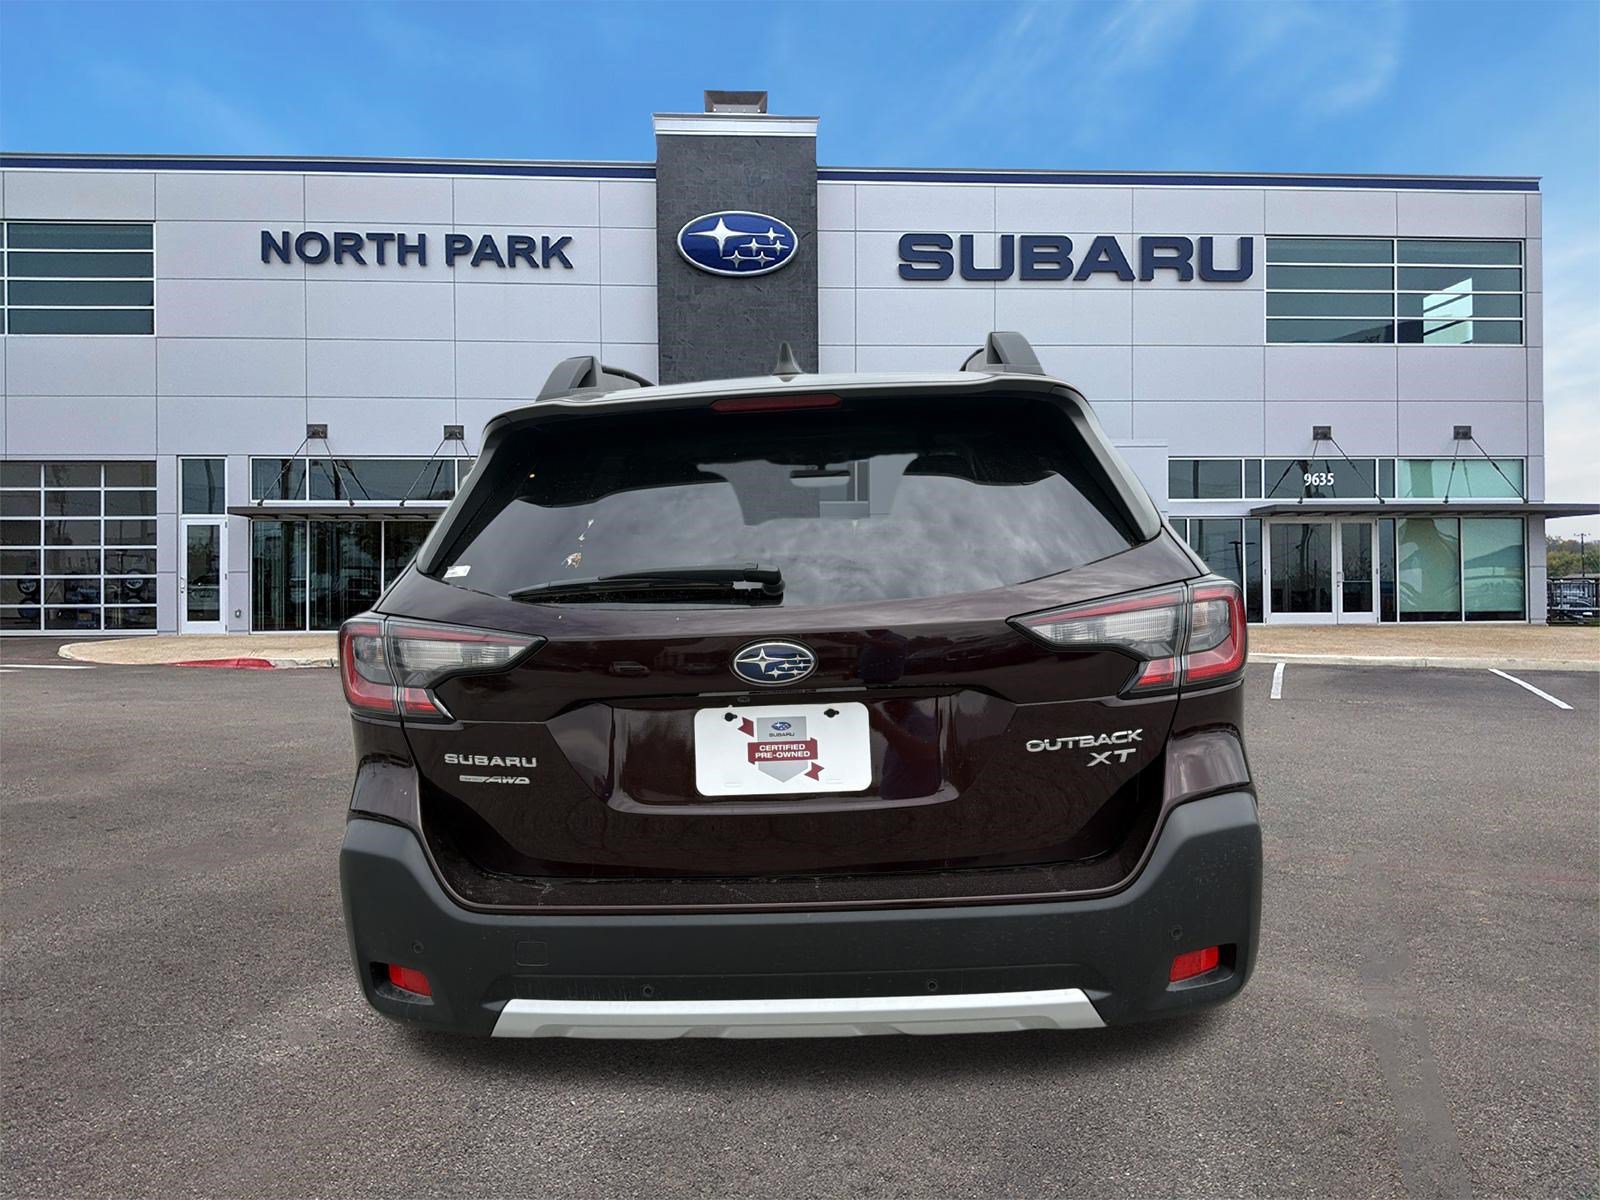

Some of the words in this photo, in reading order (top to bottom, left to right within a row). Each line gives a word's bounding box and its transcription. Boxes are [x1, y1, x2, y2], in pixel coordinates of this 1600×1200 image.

[260, 230, 427, 266] NORTH
[444, 233, 574, 269] PARK
[898, 232, 1254, 282] SUBARU
[1303, 472, 1335, 486] 9635
[759, 743, 805, 751] CERTIFIED
[1026, 728, 1144, 752] OUTBACK
[443, 753, 537, 768] SUBARU
[1086, 747, 1137, 767] XT
